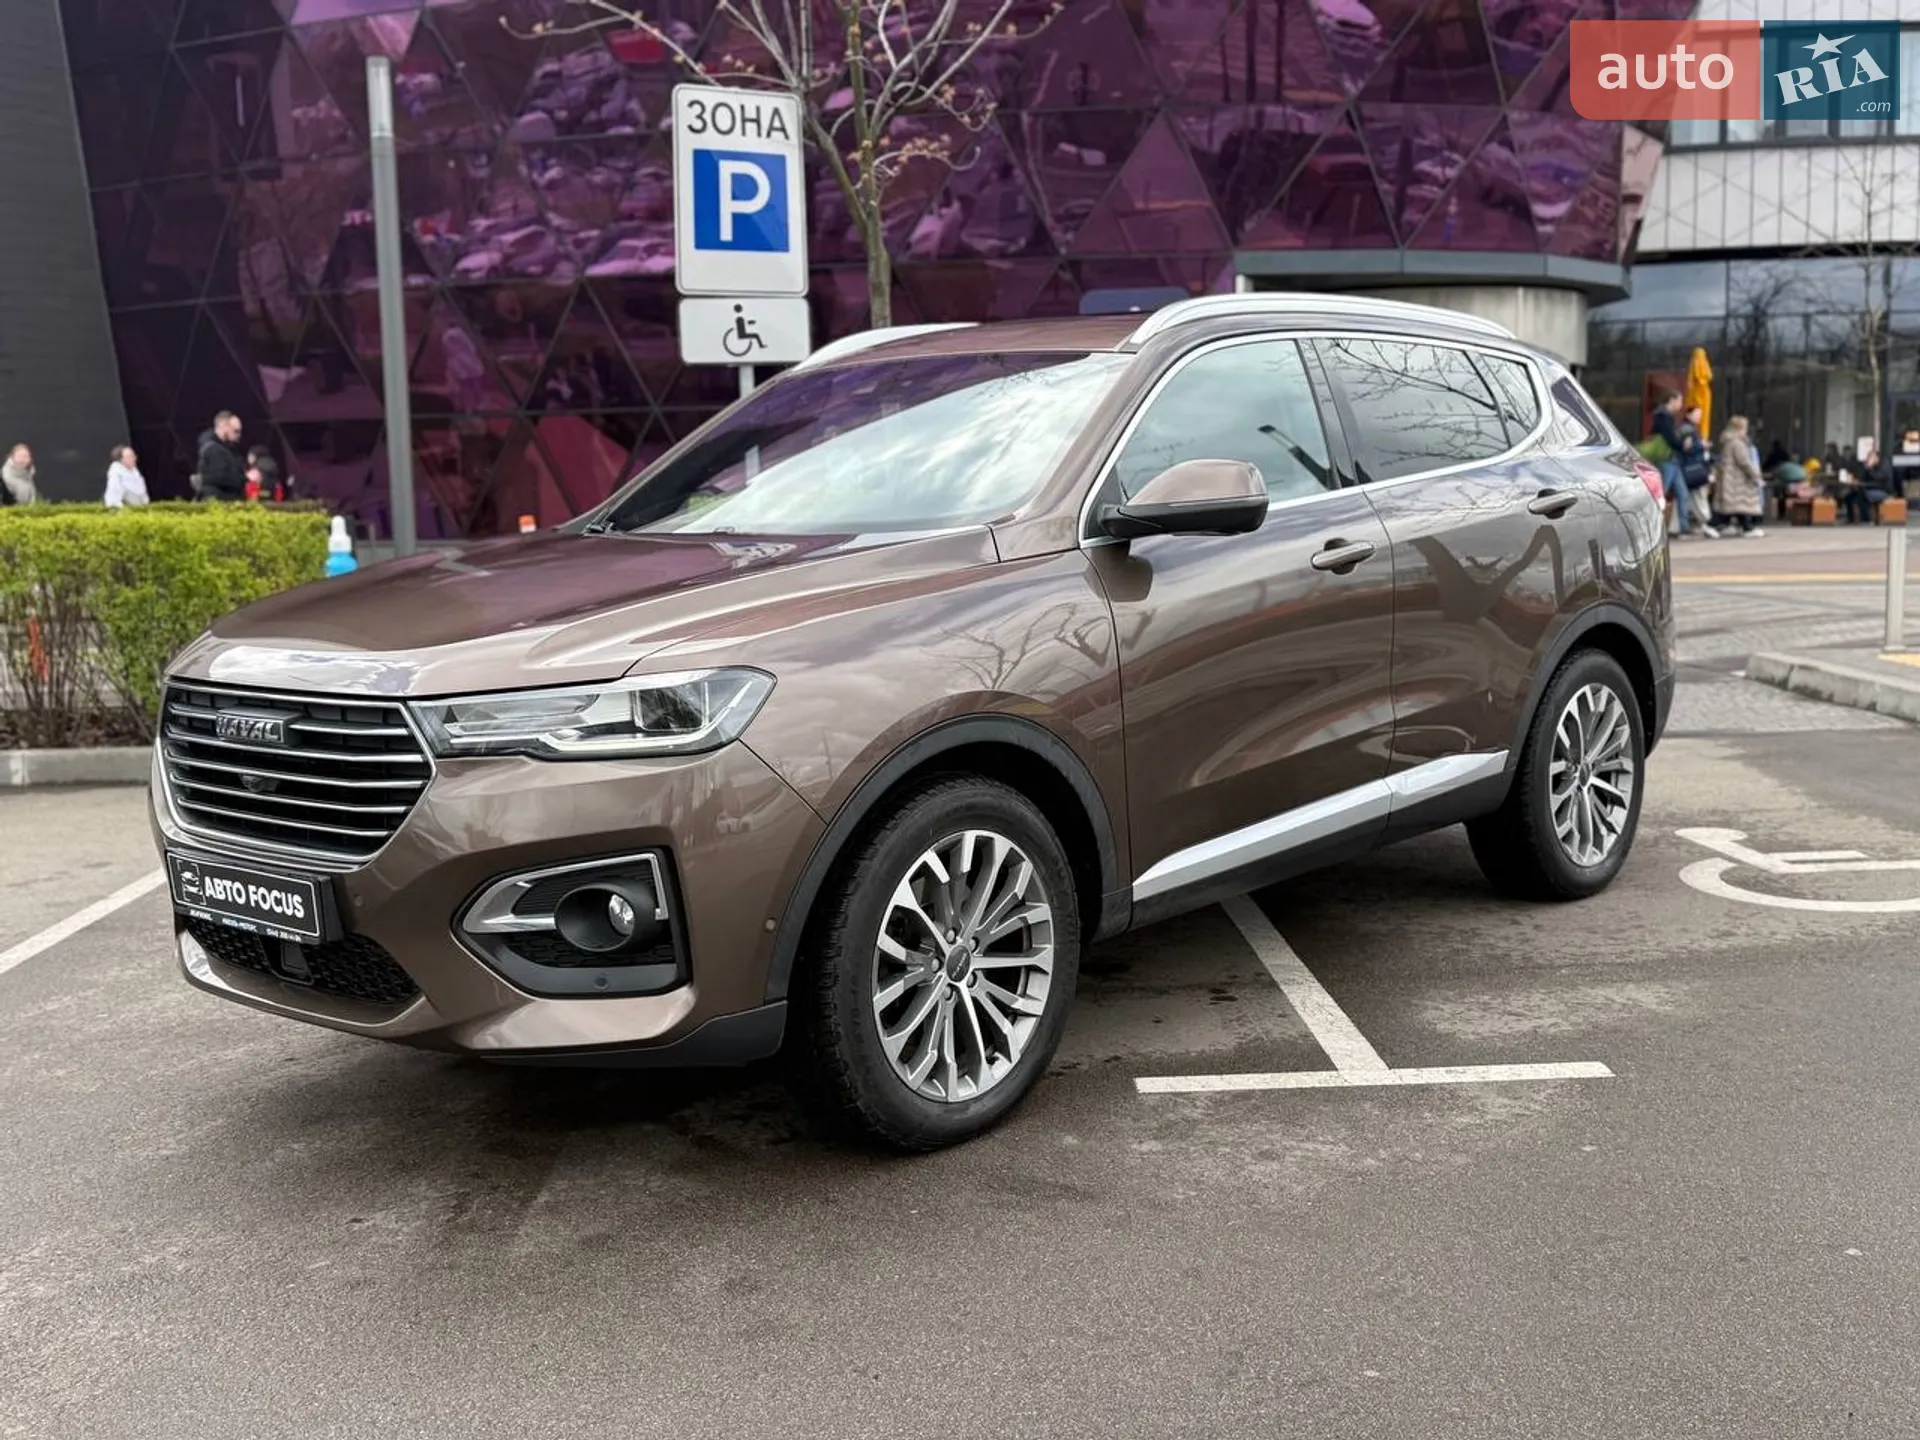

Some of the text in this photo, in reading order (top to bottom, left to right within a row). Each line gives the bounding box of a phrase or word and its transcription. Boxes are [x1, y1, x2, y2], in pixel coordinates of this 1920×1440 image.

[686, 99, 790, 141] ЗОНА
[718, 159, 771, 242] P
[204, 876, 246, 905] АВТО
[248, 885, 305, 919] FOCUS
